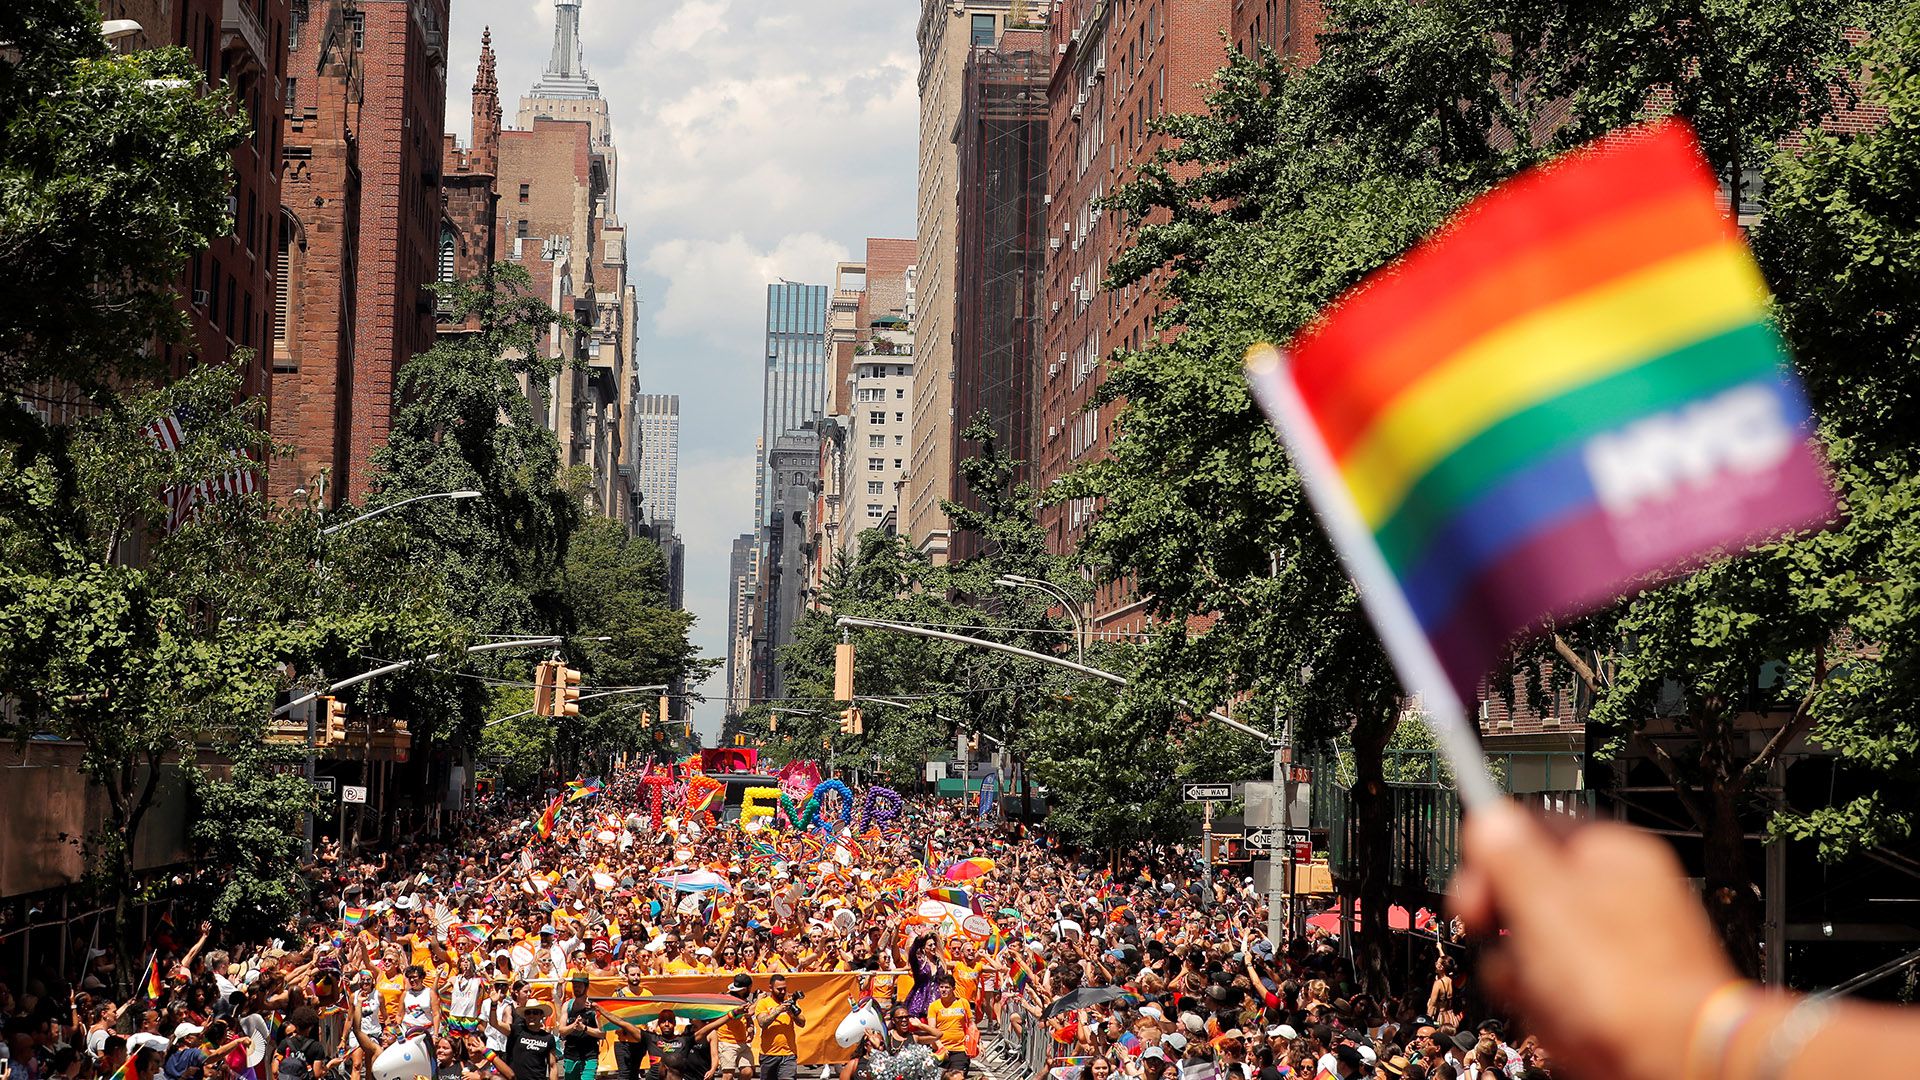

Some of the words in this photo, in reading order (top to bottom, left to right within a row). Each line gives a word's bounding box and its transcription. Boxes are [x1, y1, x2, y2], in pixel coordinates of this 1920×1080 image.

[1585, 383, 1792, 514] NYC
[273, 764, 281, 774] W
[1190, 789, 1206, 797] ONE
[1210, 789, 1226, 797] WAY
[643, 774, 901, 837] TREVOR
[1253, 834, 1272, 844] ONE
